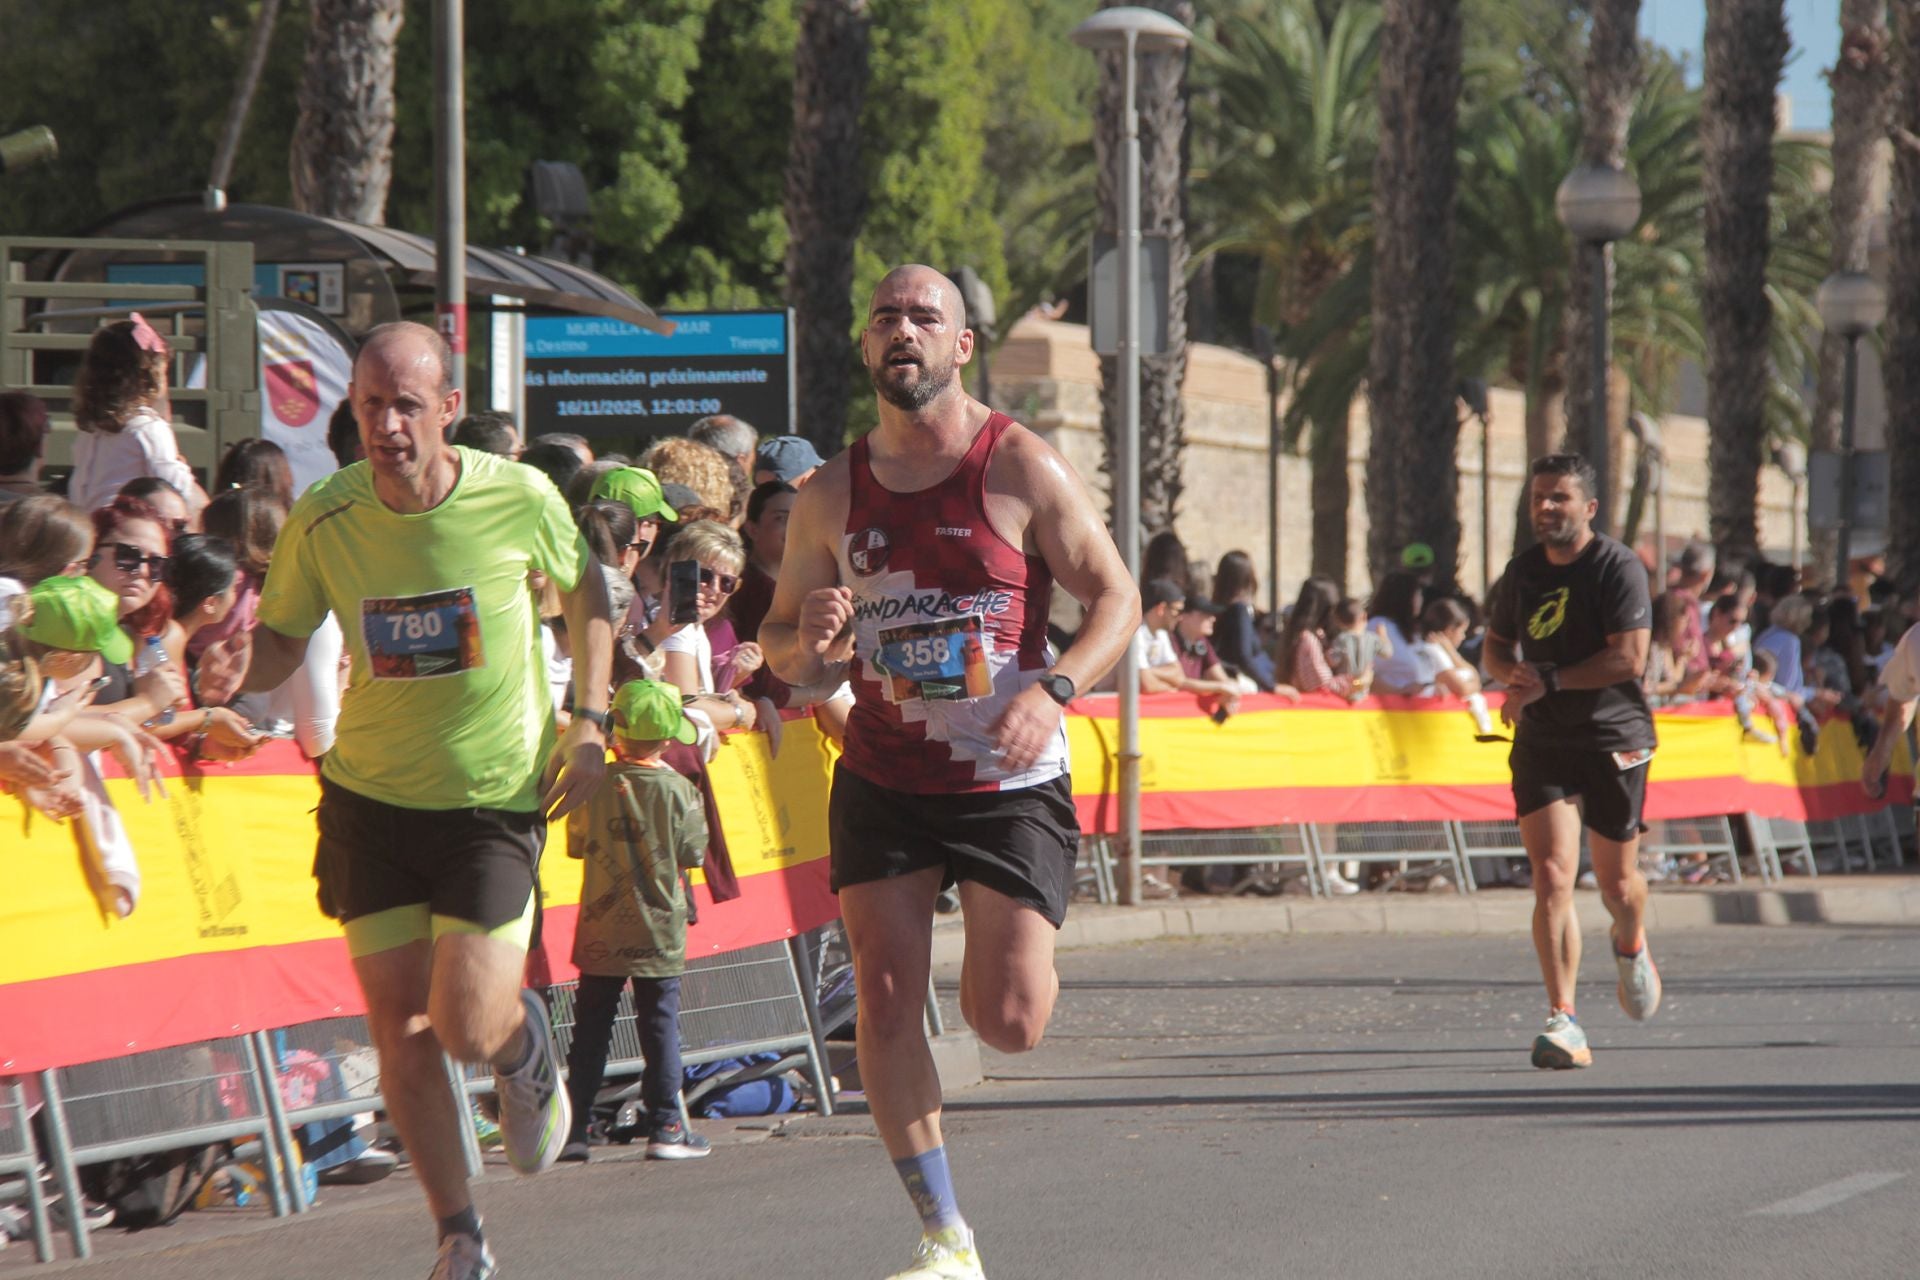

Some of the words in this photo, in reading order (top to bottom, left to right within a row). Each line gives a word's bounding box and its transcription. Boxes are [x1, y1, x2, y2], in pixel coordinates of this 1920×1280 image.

[566, 320, 640, 336] MURALLA
[535, 340, 588, 352] Destino
[729, 335, 779, 351] Tiempo
[525, 370, 544, 386] ás
[547, 369, 647, 386] información
[649, 367, 768, 388] próximamente
[557, 399, 648, 416] 16/11/2025,
[651, 398, 721, 414] 12:03:00
[935, 527, 972, 537] FASTER
[386, 611, 443, 641] 780
[901, 637, 950, 668] 358
